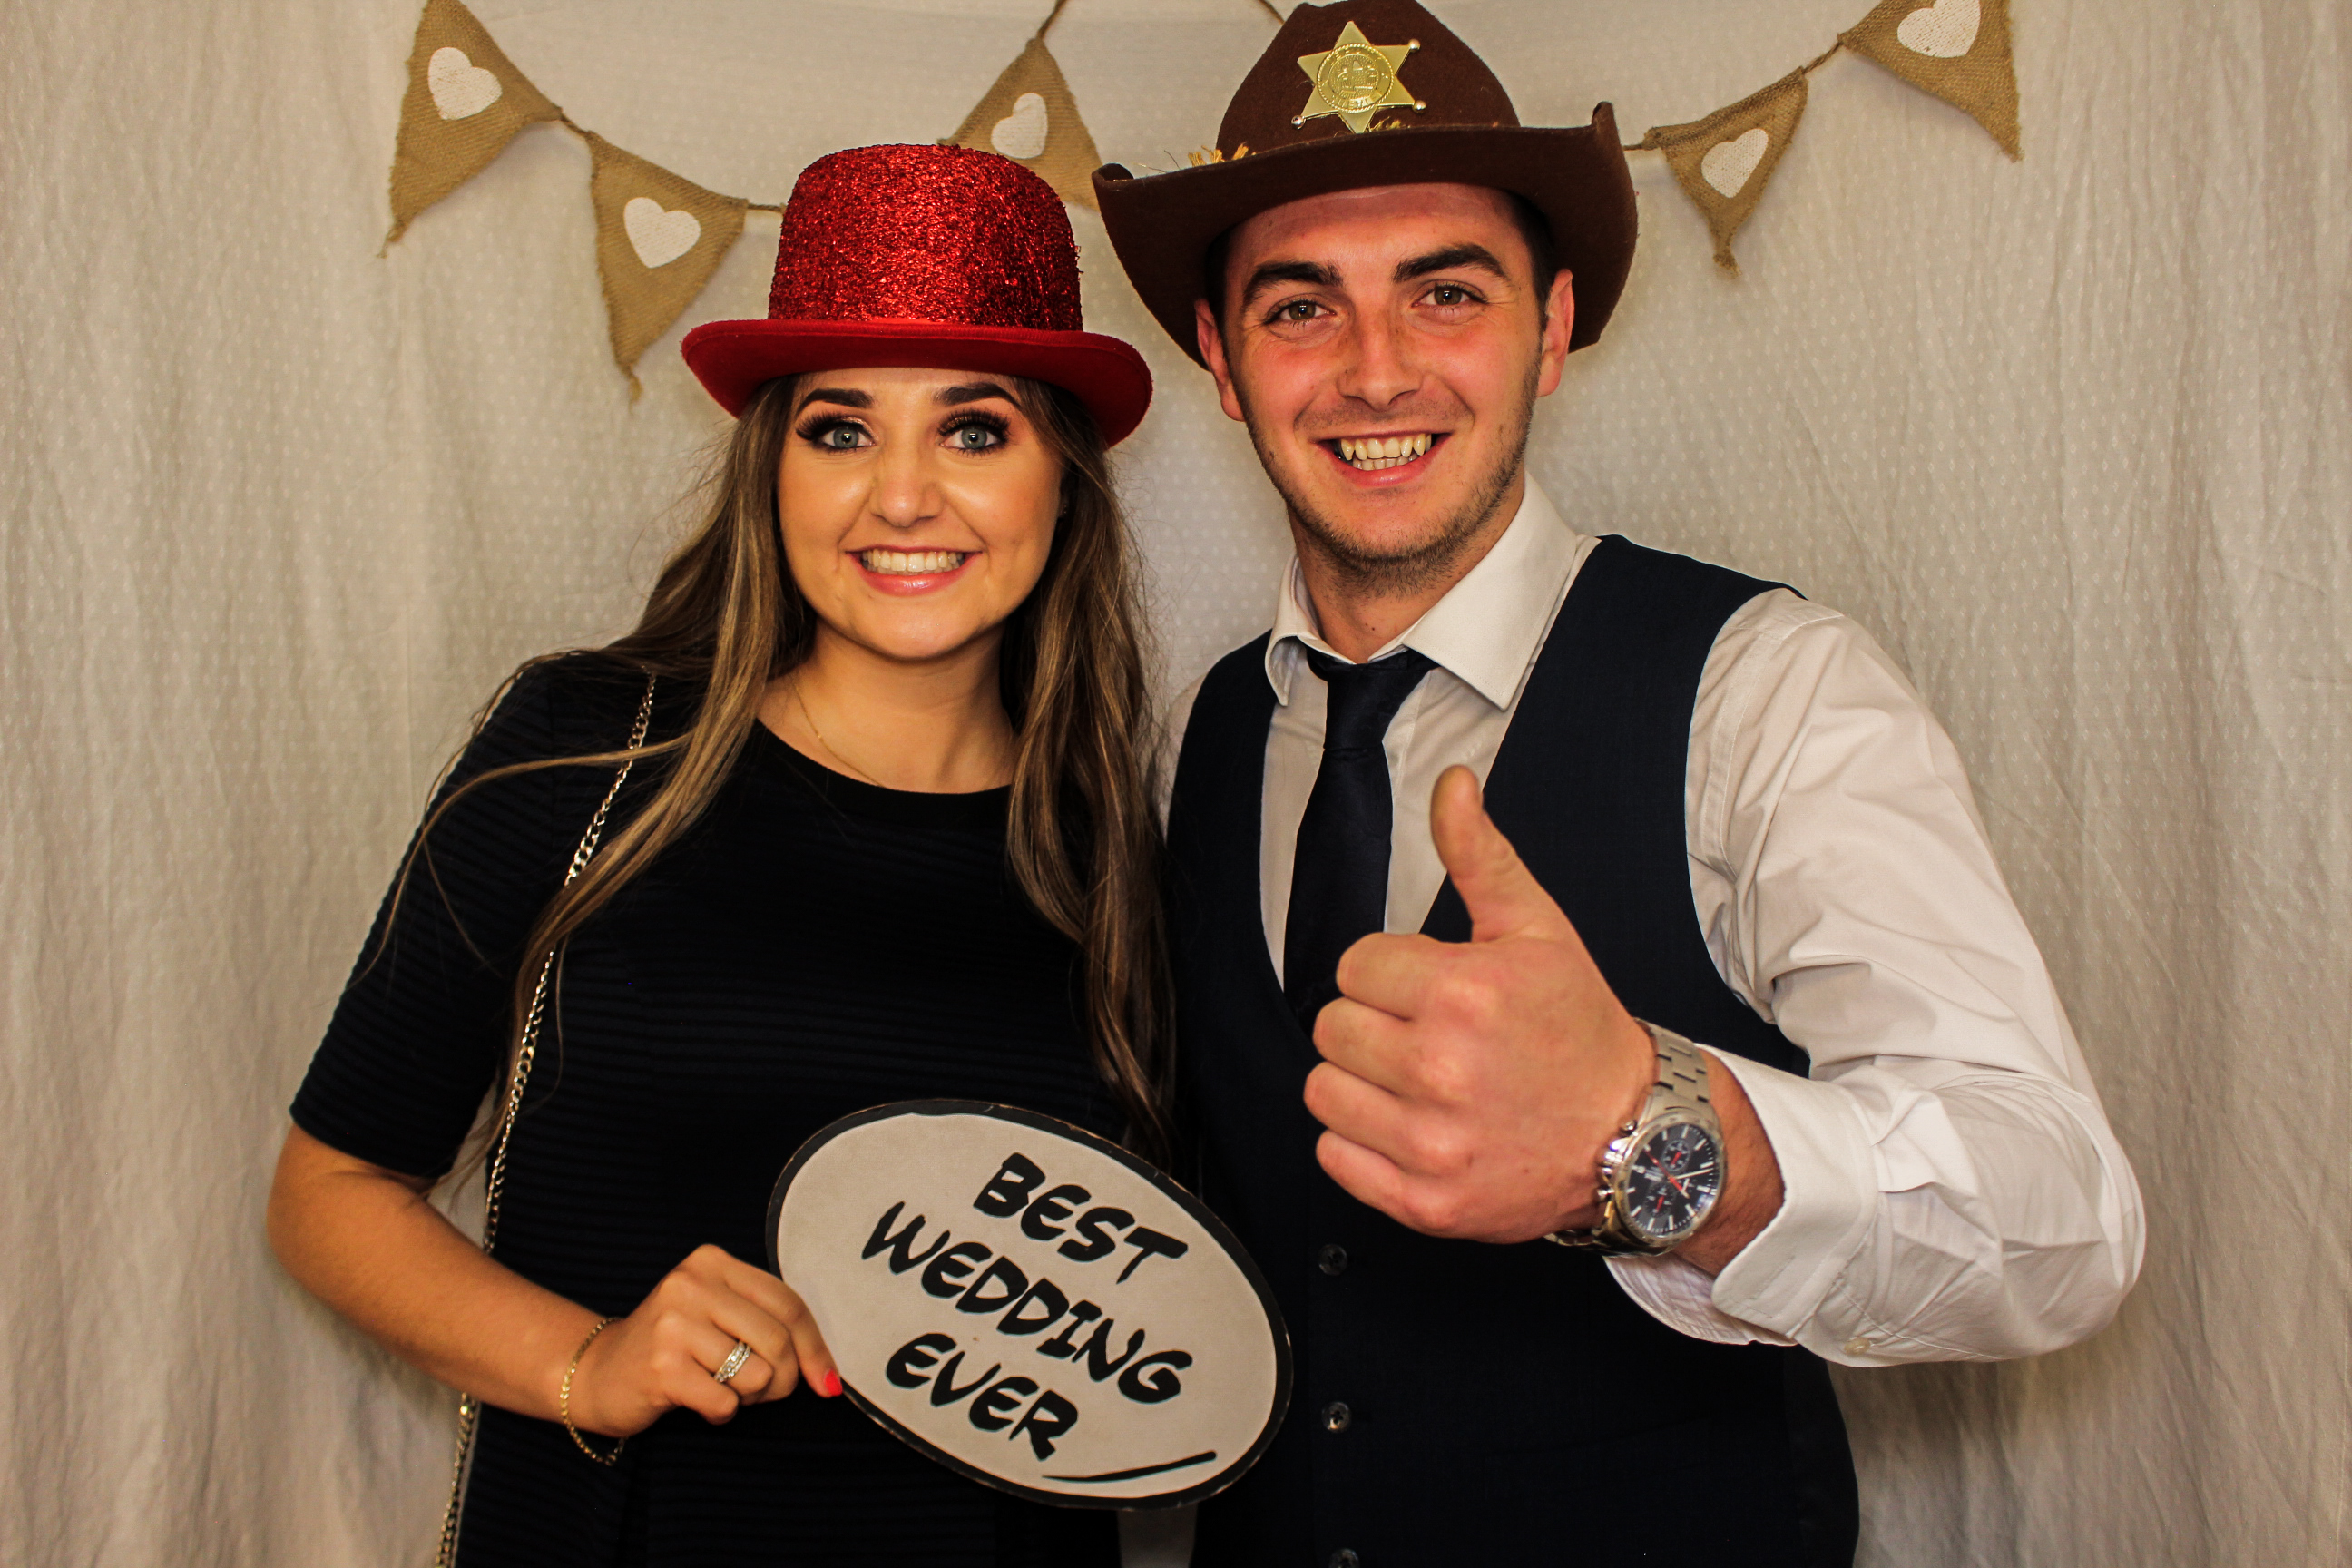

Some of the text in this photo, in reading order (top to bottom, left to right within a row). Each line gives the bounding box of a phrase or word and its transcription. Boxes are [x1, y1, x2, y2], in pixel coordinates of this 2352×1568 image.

[973, 1152, 1188, 1284] BEST
[862, 1201, 1193, 1404] WEDDING
[886, 1333, 1078, 1462] EVER
